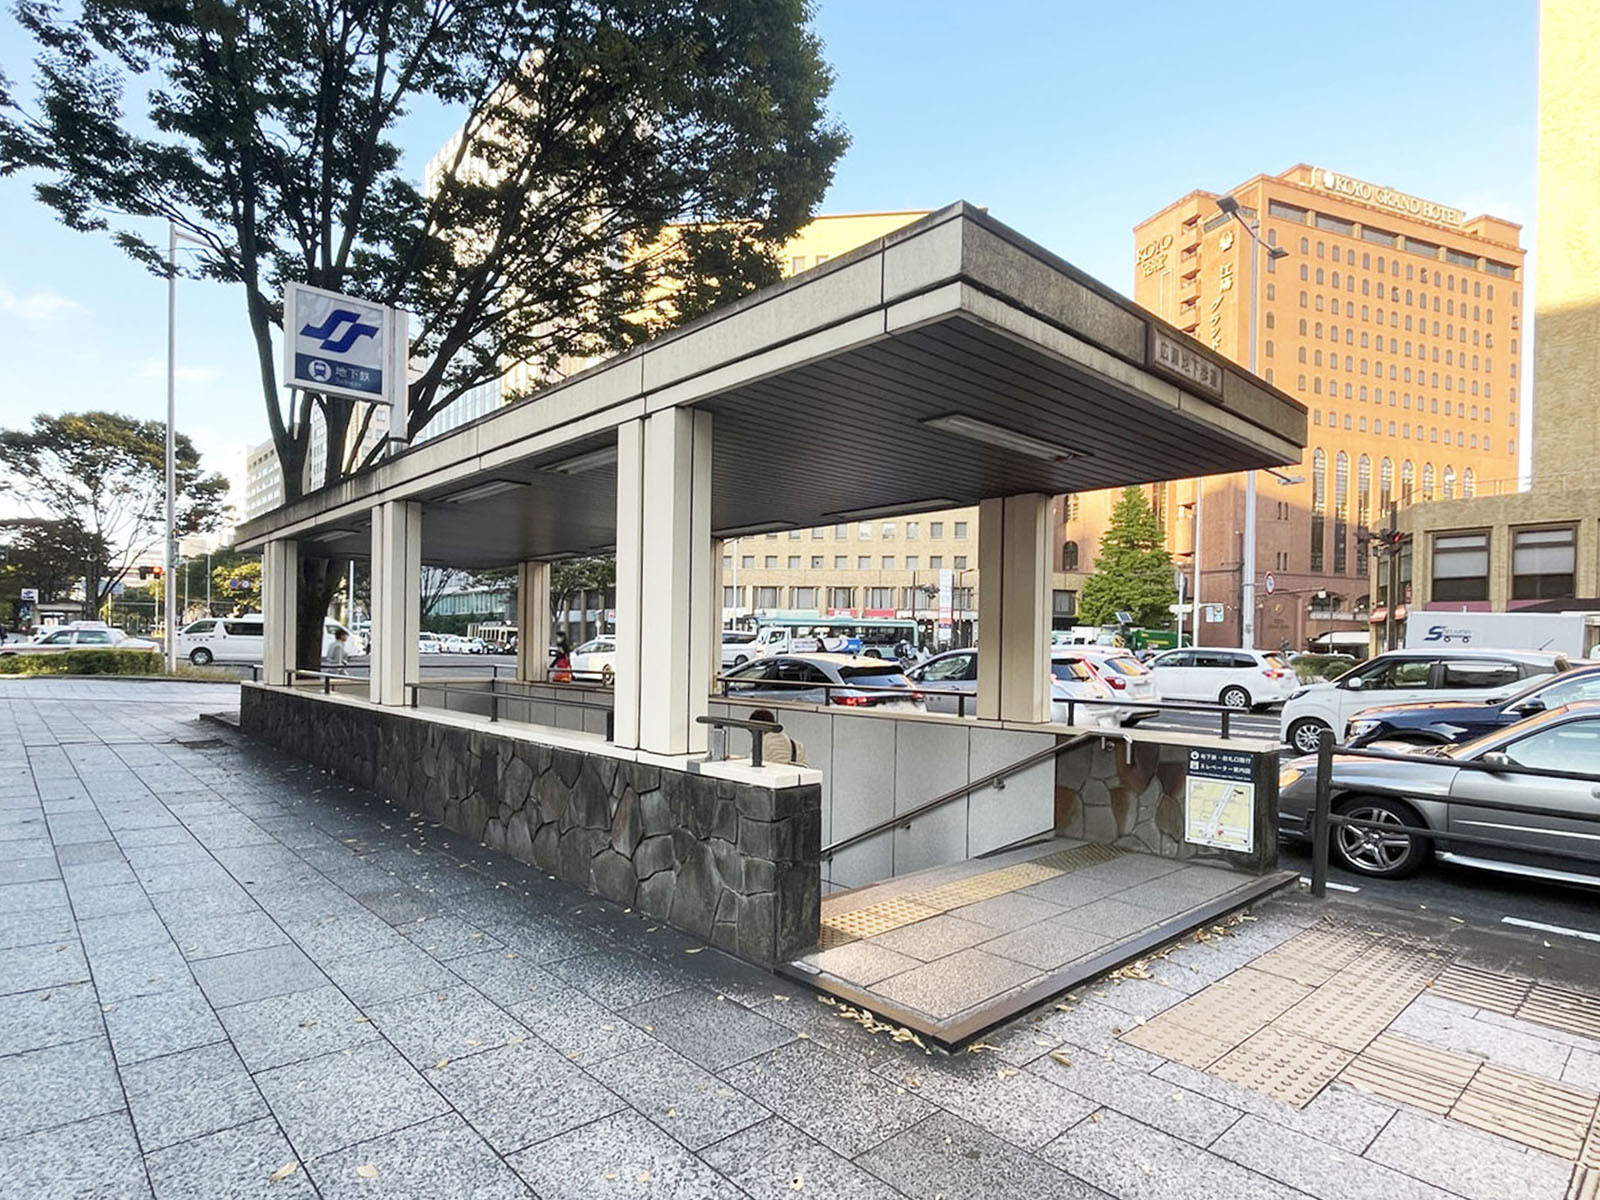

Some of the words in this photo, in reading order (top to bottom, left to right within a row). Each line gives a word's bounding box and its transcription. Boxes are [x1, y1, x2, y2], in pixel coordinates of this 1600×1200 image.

[1335, 175, 1372, 200] KOYO
[1375, 188, 1420, 214] GRAND
[1423, 201, 1460, 227] HOTEL
[335, 366, 370, 381] 地下鉄
